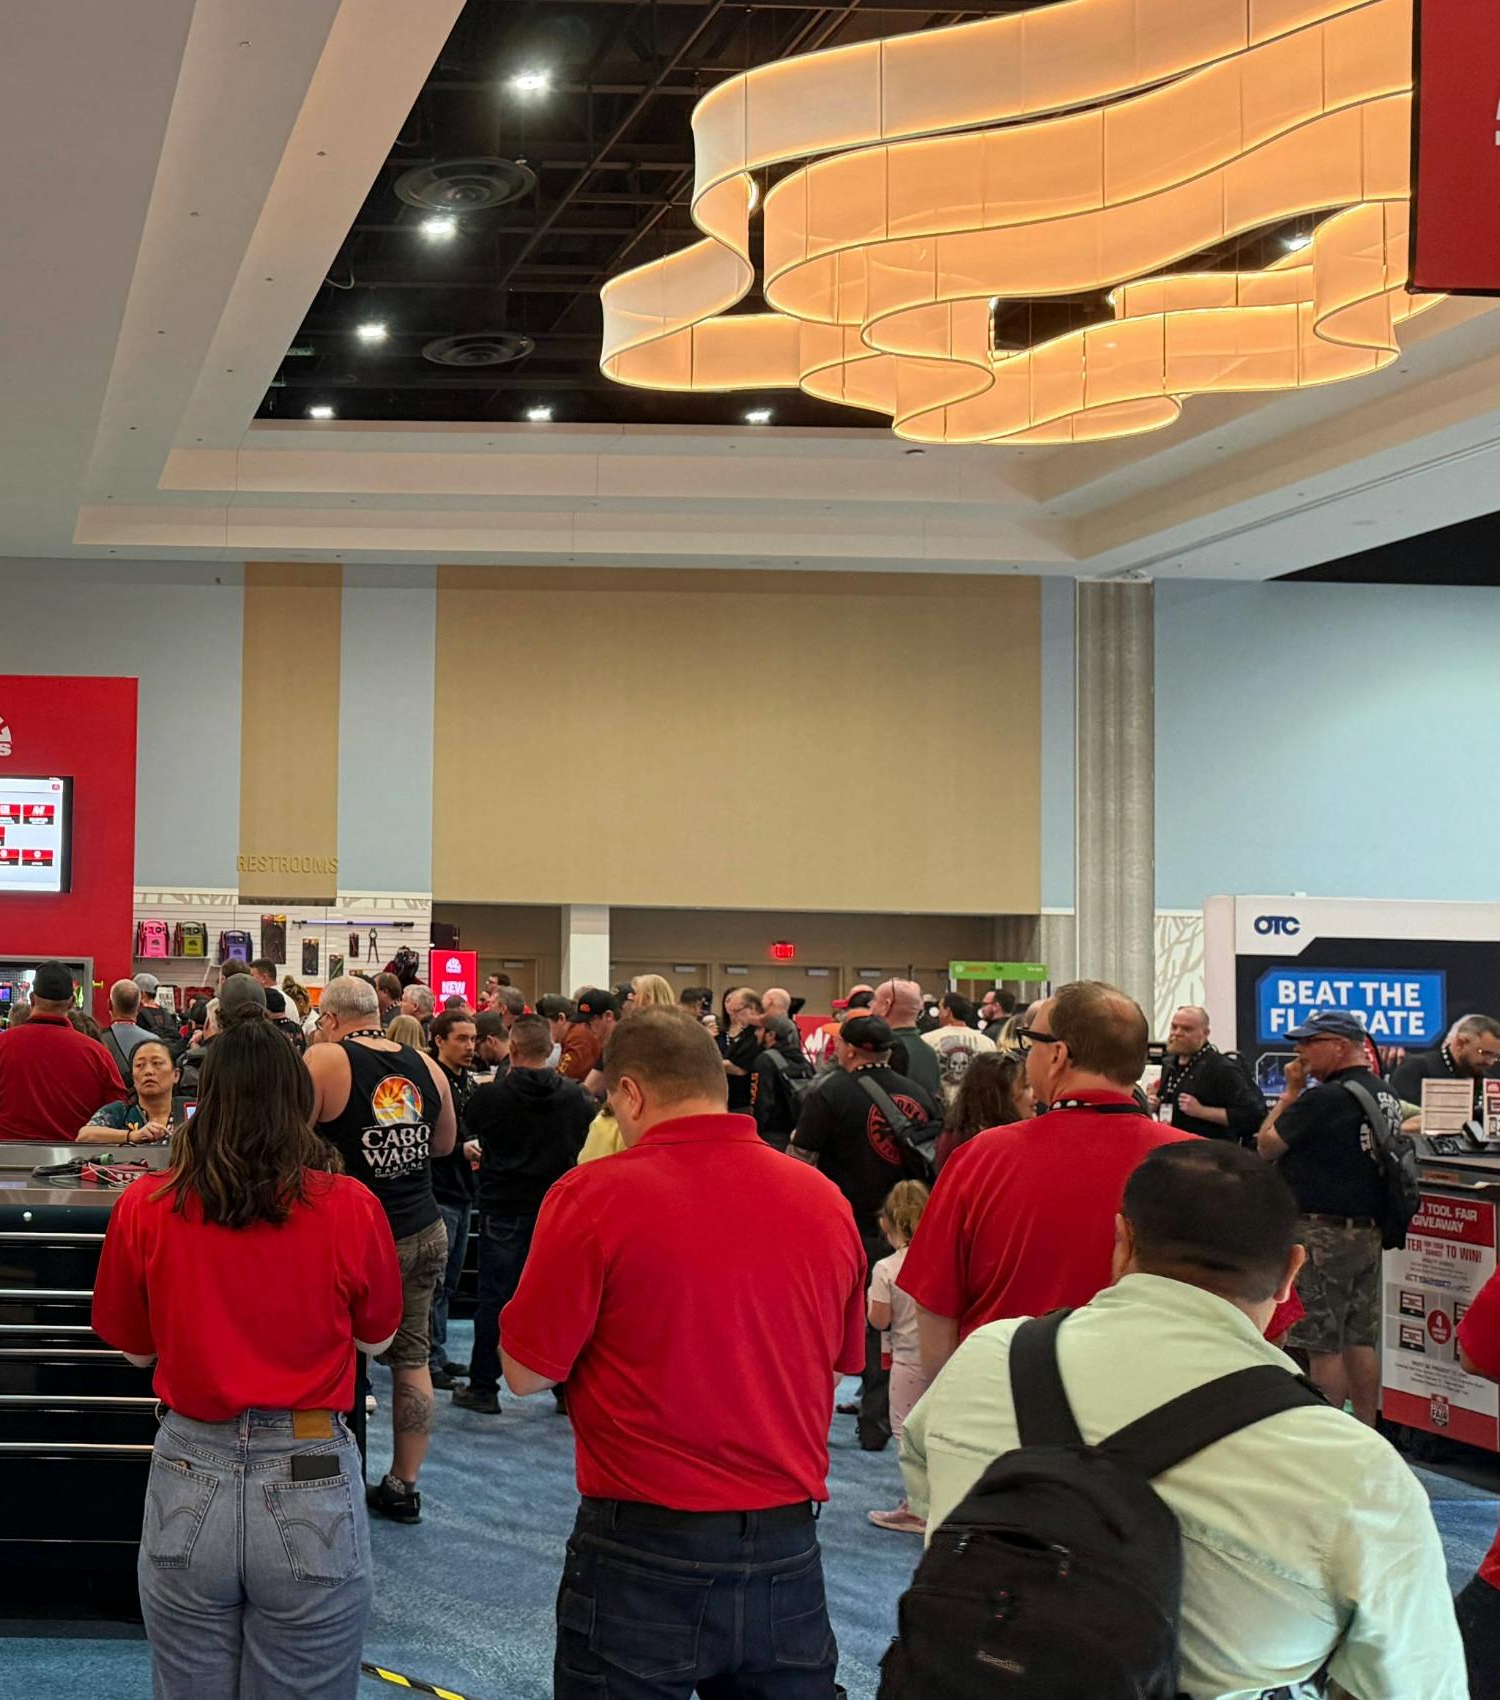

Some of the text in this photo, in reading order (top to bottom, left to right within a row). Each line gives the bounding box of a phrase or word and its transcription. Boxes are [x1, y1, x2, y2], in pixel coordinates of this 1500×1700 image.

[236, 856, 339, 874] RESTROOMS
[1254, 916, 1300, 935] OTC
[1278, 980, 1421, 1007] BEAT THE
[361, 1124, 431, 1149] CABO
[362, 1143, 429, 1167] WABO
[1427, 1203, 1453, 1218] TOOL
[1455, 1207, 1478, 1221] FAIR
[1412, 1214, 1464, 1232] GIVEAWAY
[1446, 1245, 1457, 1258] TO
